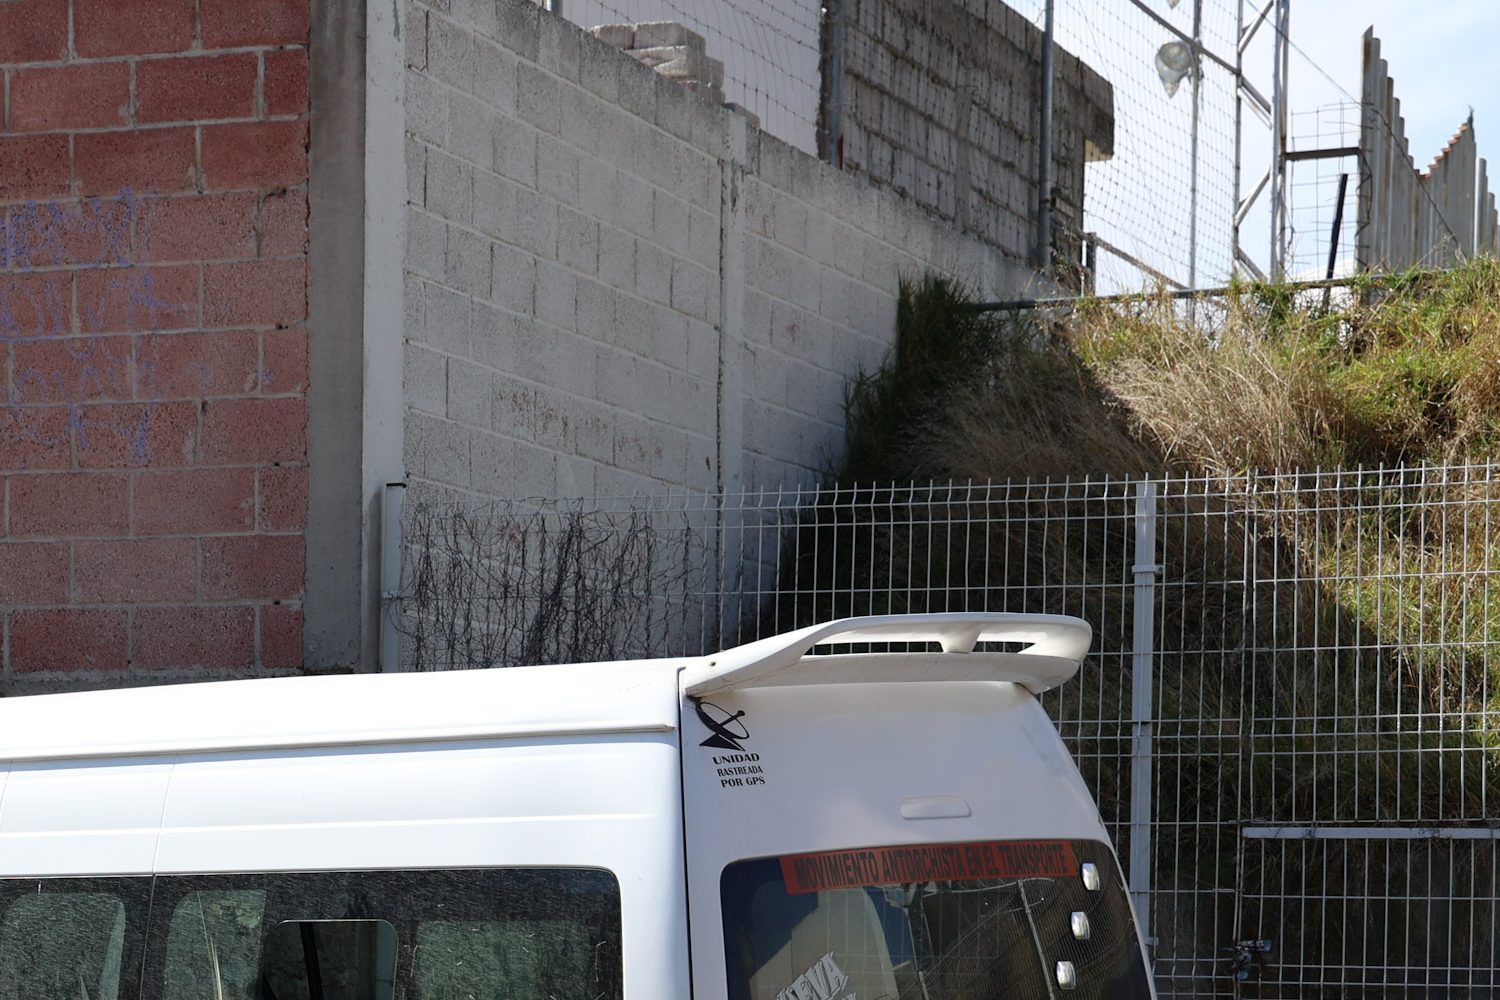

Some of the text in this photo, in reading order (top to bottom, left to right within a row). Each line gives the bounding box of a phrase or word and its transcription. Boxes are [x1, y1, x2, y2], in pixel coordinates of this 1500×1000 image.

[712, 753, 760, 765] UNIDAD
[717, 765, 763, 777] RASTREADA
[721, 776, 765, 788] POR GPS
[794, 843, 1069, 890] MOVIMIENTO ANTORCHISTA EN EL TRANSPORTE
